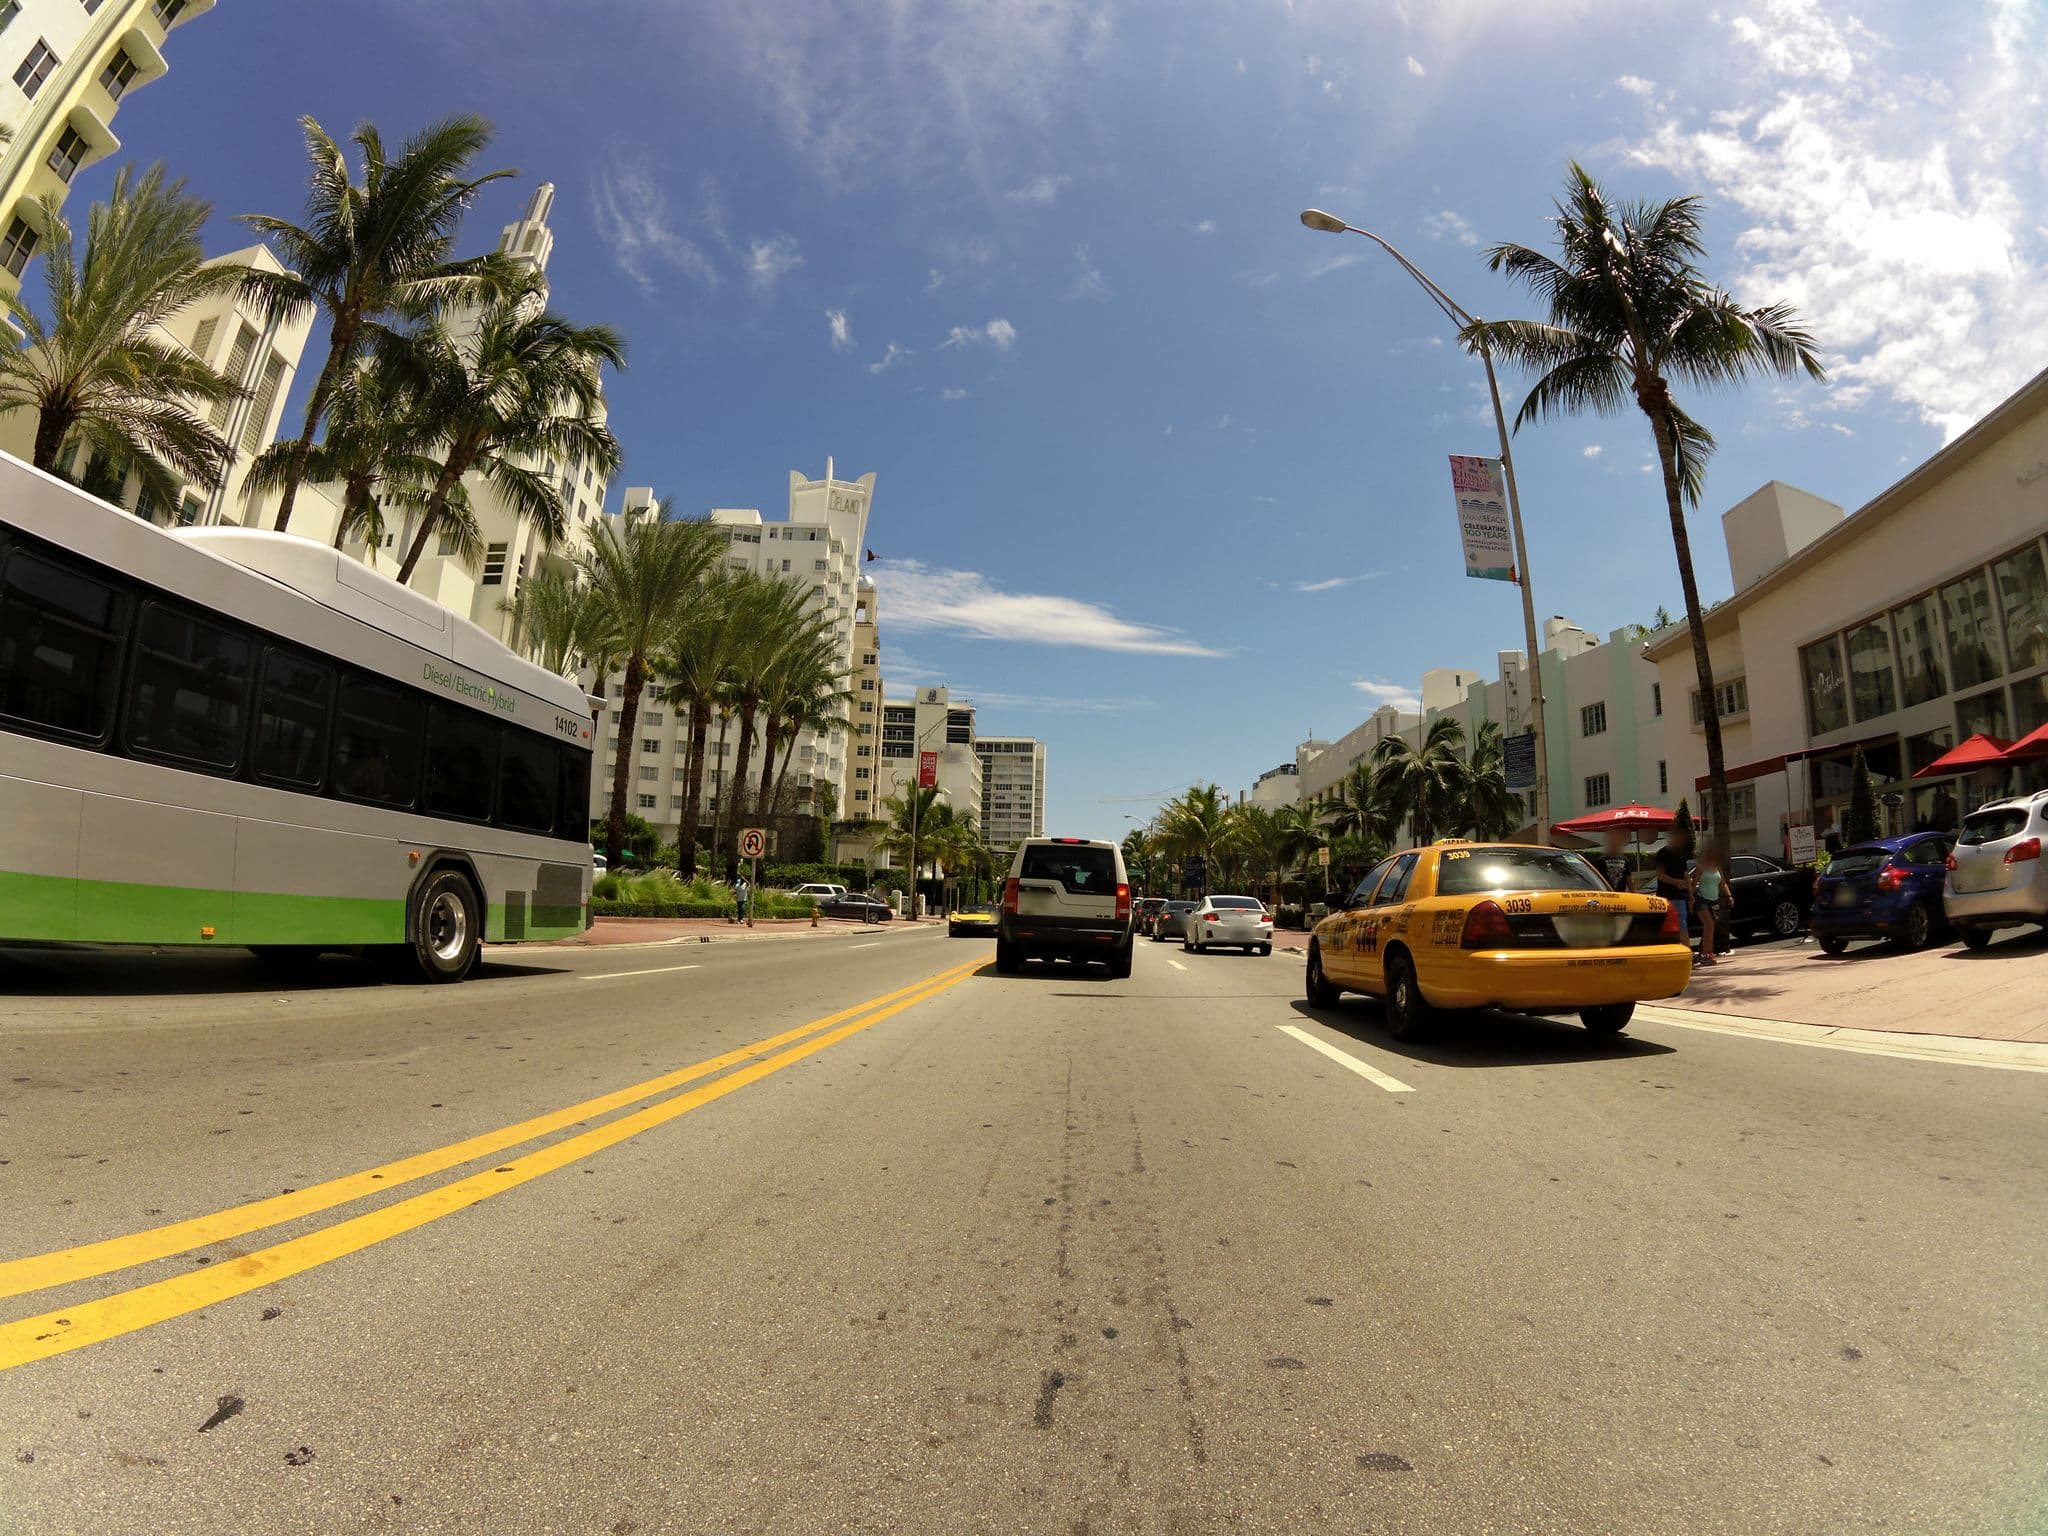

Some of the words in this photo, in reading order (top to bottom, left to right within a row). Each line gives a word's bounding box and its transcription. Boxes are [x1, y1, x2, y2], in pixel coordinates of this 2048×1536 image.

[1464, 523, 1507, 532] CELEBRATING
[1465, 529, 1481, 537] 100
[1482, 531, 1509, 540] YEARS
[423, 663, 488, 703] Diesel/Electric
[488, 688, 515, 713] Hybrid
[555, 716, 578, 737] 14102
[1447, 851, 1471, 860] 3039
[1506, 899, 1531, 913] 3039
[1647, 897, 1667, 911] 3039
